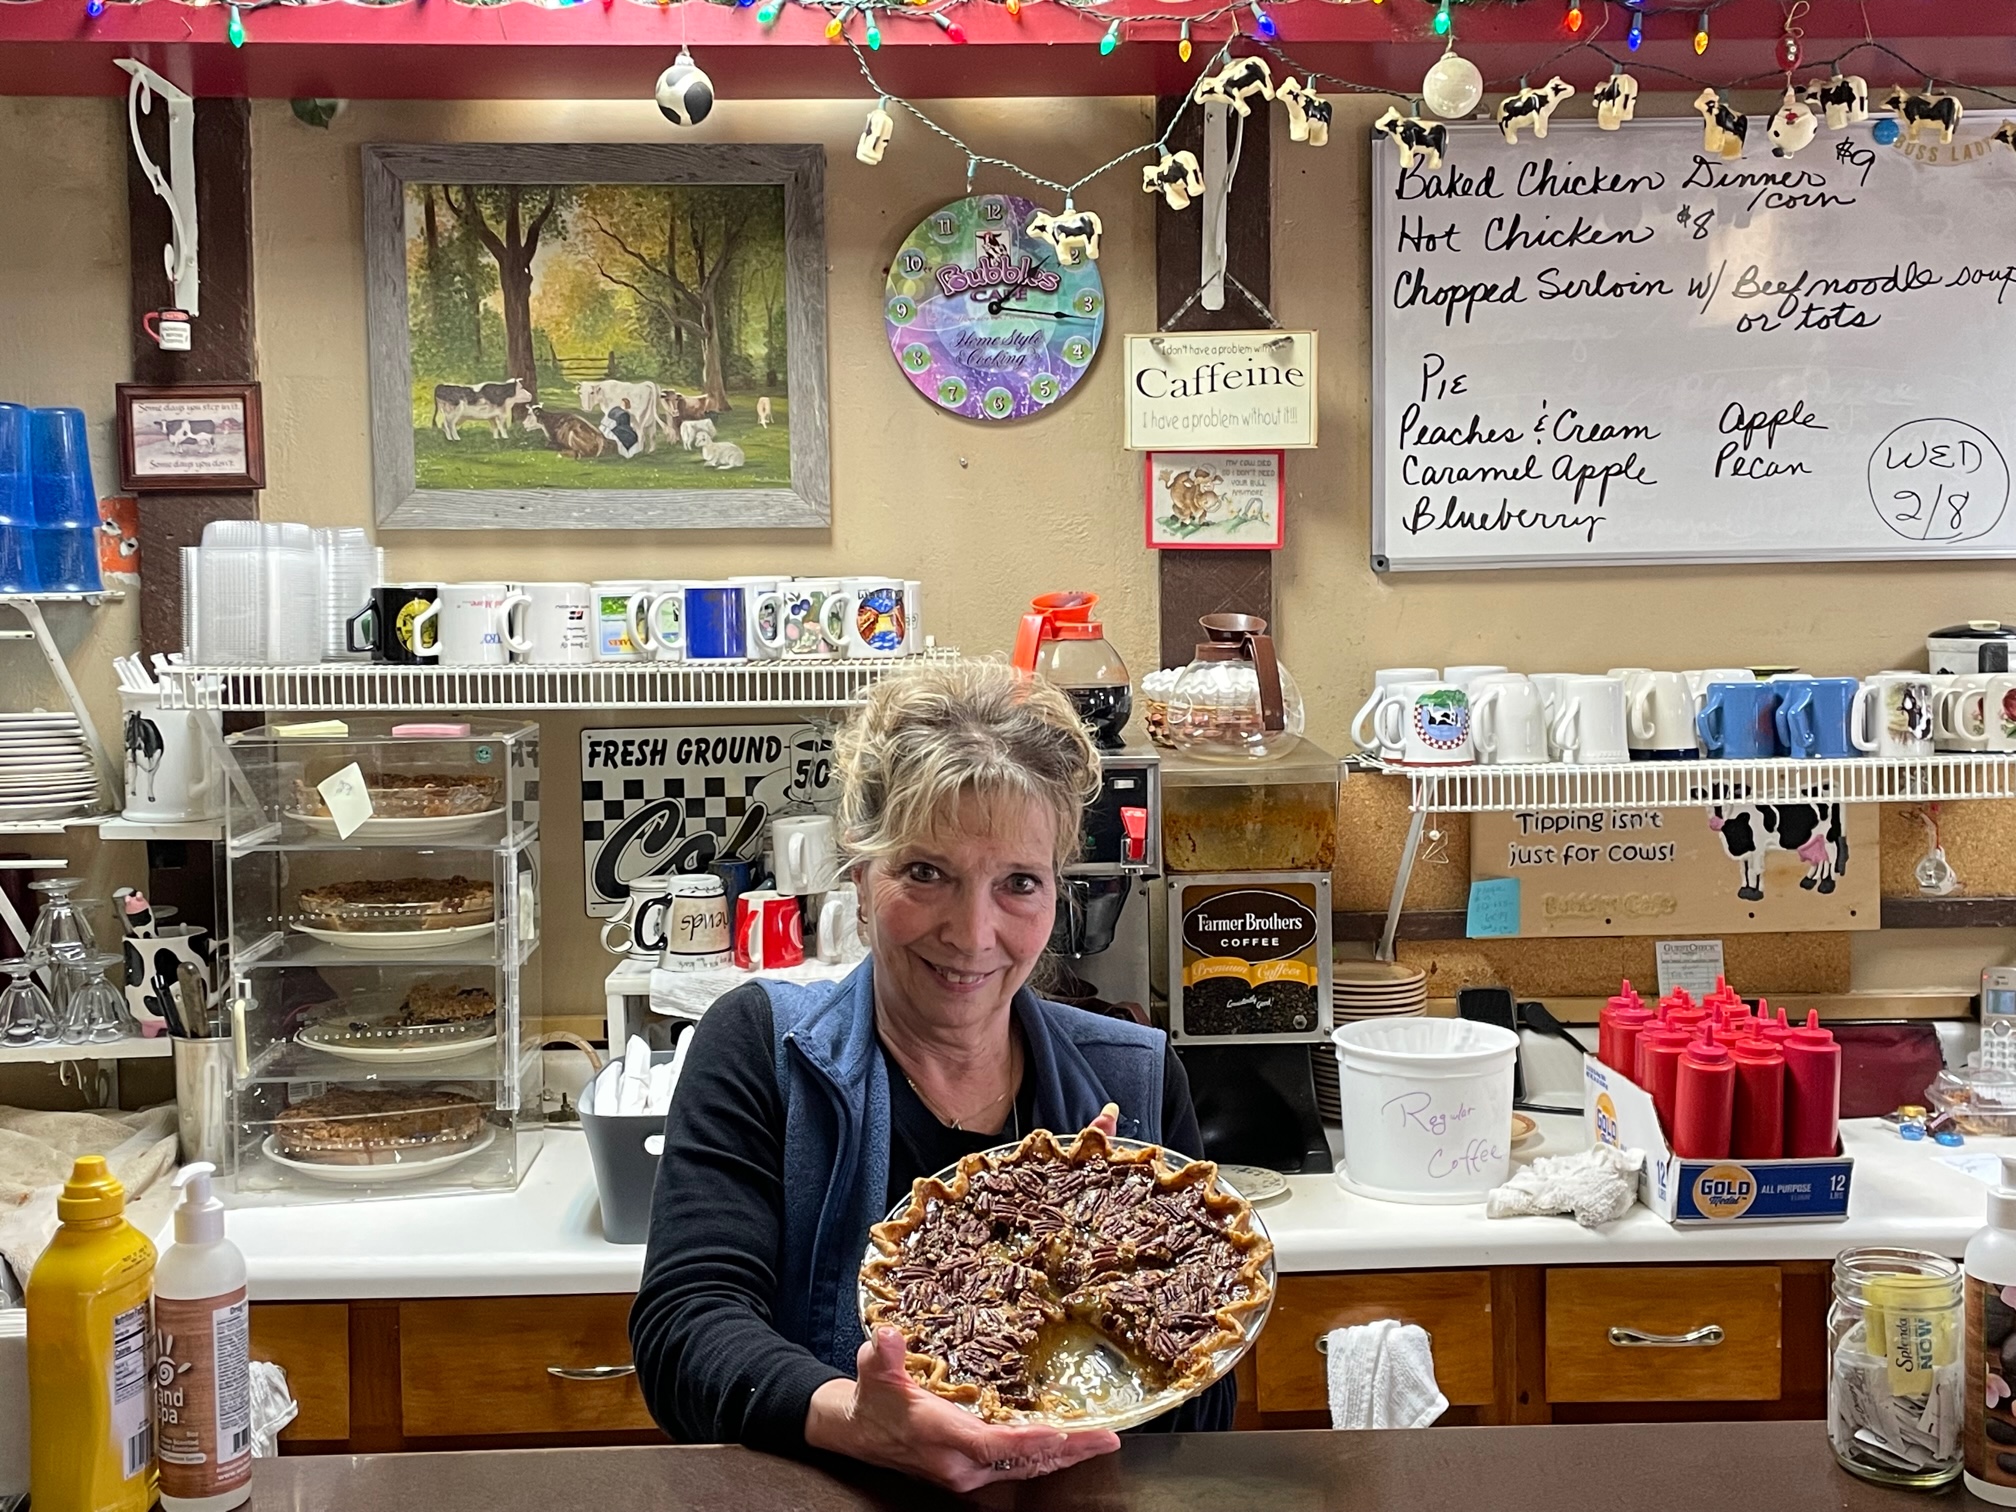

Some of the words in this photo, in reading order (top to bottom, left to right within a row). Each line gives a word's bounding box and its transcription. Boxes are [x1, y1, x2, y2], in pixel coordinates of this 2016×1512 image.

[1951, 136, 1992, 160] LADY
[1396, 153, 1504, 200] Baked
[1518, 159, 1664, 196] Chicken
[1682, 154, 1826, 189] Dinner
[1836, 137, 1876, 186] $9
[986, 204, 1002, 221] 12
[937, 219, 952, 235] 11
[1398, 215, 1461, 252] Hot
[1485, 214, 1654, 250] Chicken
[1677, 204, 1714, 240] $8
[905, 255, 923, 272] 10
[936, 256, 1060, 297] Bubbles
[1394, 268, 1527, 324] Chopped
[1732, 265, 1809, 318] Beef
[1805, 261, 1942, 297] noodle
[897, 304, 907, 318] 9
[1084, 297, 1094, 312] 3
[1737, 312, 1780, 332] or
[1795, 303, 1881, 330] tots
[954, 329, 999, 348] Home
[1001, 329, 1043, 351] Style
[1167, 344, 1187, 355] don't
[1190, 346, 1209, 355] have
[1218, 343, 1252, 356] problem
[913, 351, 923, 366] 8
[966, 350, 1028, 368] Cooking
[1072, 344, 1084, 359] 4
[1040, 380, 1051, 396] 5
[1136, 358, 1305, 398] Caffeine
[948, 386, 958, 401] 7
[993, 396, 1004, 411] 6
[138, 402, 161, 413] Some
[164, 404, 185, 415] days
[187, 405, 200, 415] you
[1143, 412, 1147, 428] I
[1151, 410, 1179, 430] have
[1182, 415, 1189, 428] a
[1192, 406, 1239, 432] problem
[1242, 407, 1281, 426] without
[1400, 402, 1524, 450] Peaches
[1553, 409, 1660, 442] Cream
[149, 460, 171, 470] Some
[173, 461, 193, 472] days
[195, 461, 211, 472] you
[1715, 441, 1812, 479] Pecan
[1887, 441, 1982, 474] WED
[1403, 454, 1542, 485] Caramel
[1403, 496, 1606, 542] Blueberry
[1894, 484, 1969, 540] 2/8
[588, 738, 668, 769] FRESH
[676, 736, 781, 765] GROUND
[1516, 811, 1603, 836] Tipping
[1612, 809, 1662, 829] isn't
[1509, 844, 1555, 867] just
[1562, 843, 1600, 864] for
[680, 910, 728, 941] riends
[1198, 914, 1244, 931] Farmer
[1246, 913, 1302, 930] Brothers
[1221, 938, 1279, 947] COFFEE
[1194, 962, 1248, 976] Premium
[1257, 962, 1301, 980] Coffees
[1597, 1108, 1616, 1140] GOLD
[1428, 1139, 1502, 1178] Coffee
[1657, 1160, 1666, 1188] 12
[1830, 1174, 1846, 1192] 12
[1701, 1179, 1750, 1196] GOLD
[1762, 1184, 1774, 1194] ALL
[1777, 1183, 1812, 1193] PURPOSE
[1709, 1196, 1740, 1206] Medal
[1895, 1318, 1914, 1372] Splenda
[157, 1387, 184, 1407] and
